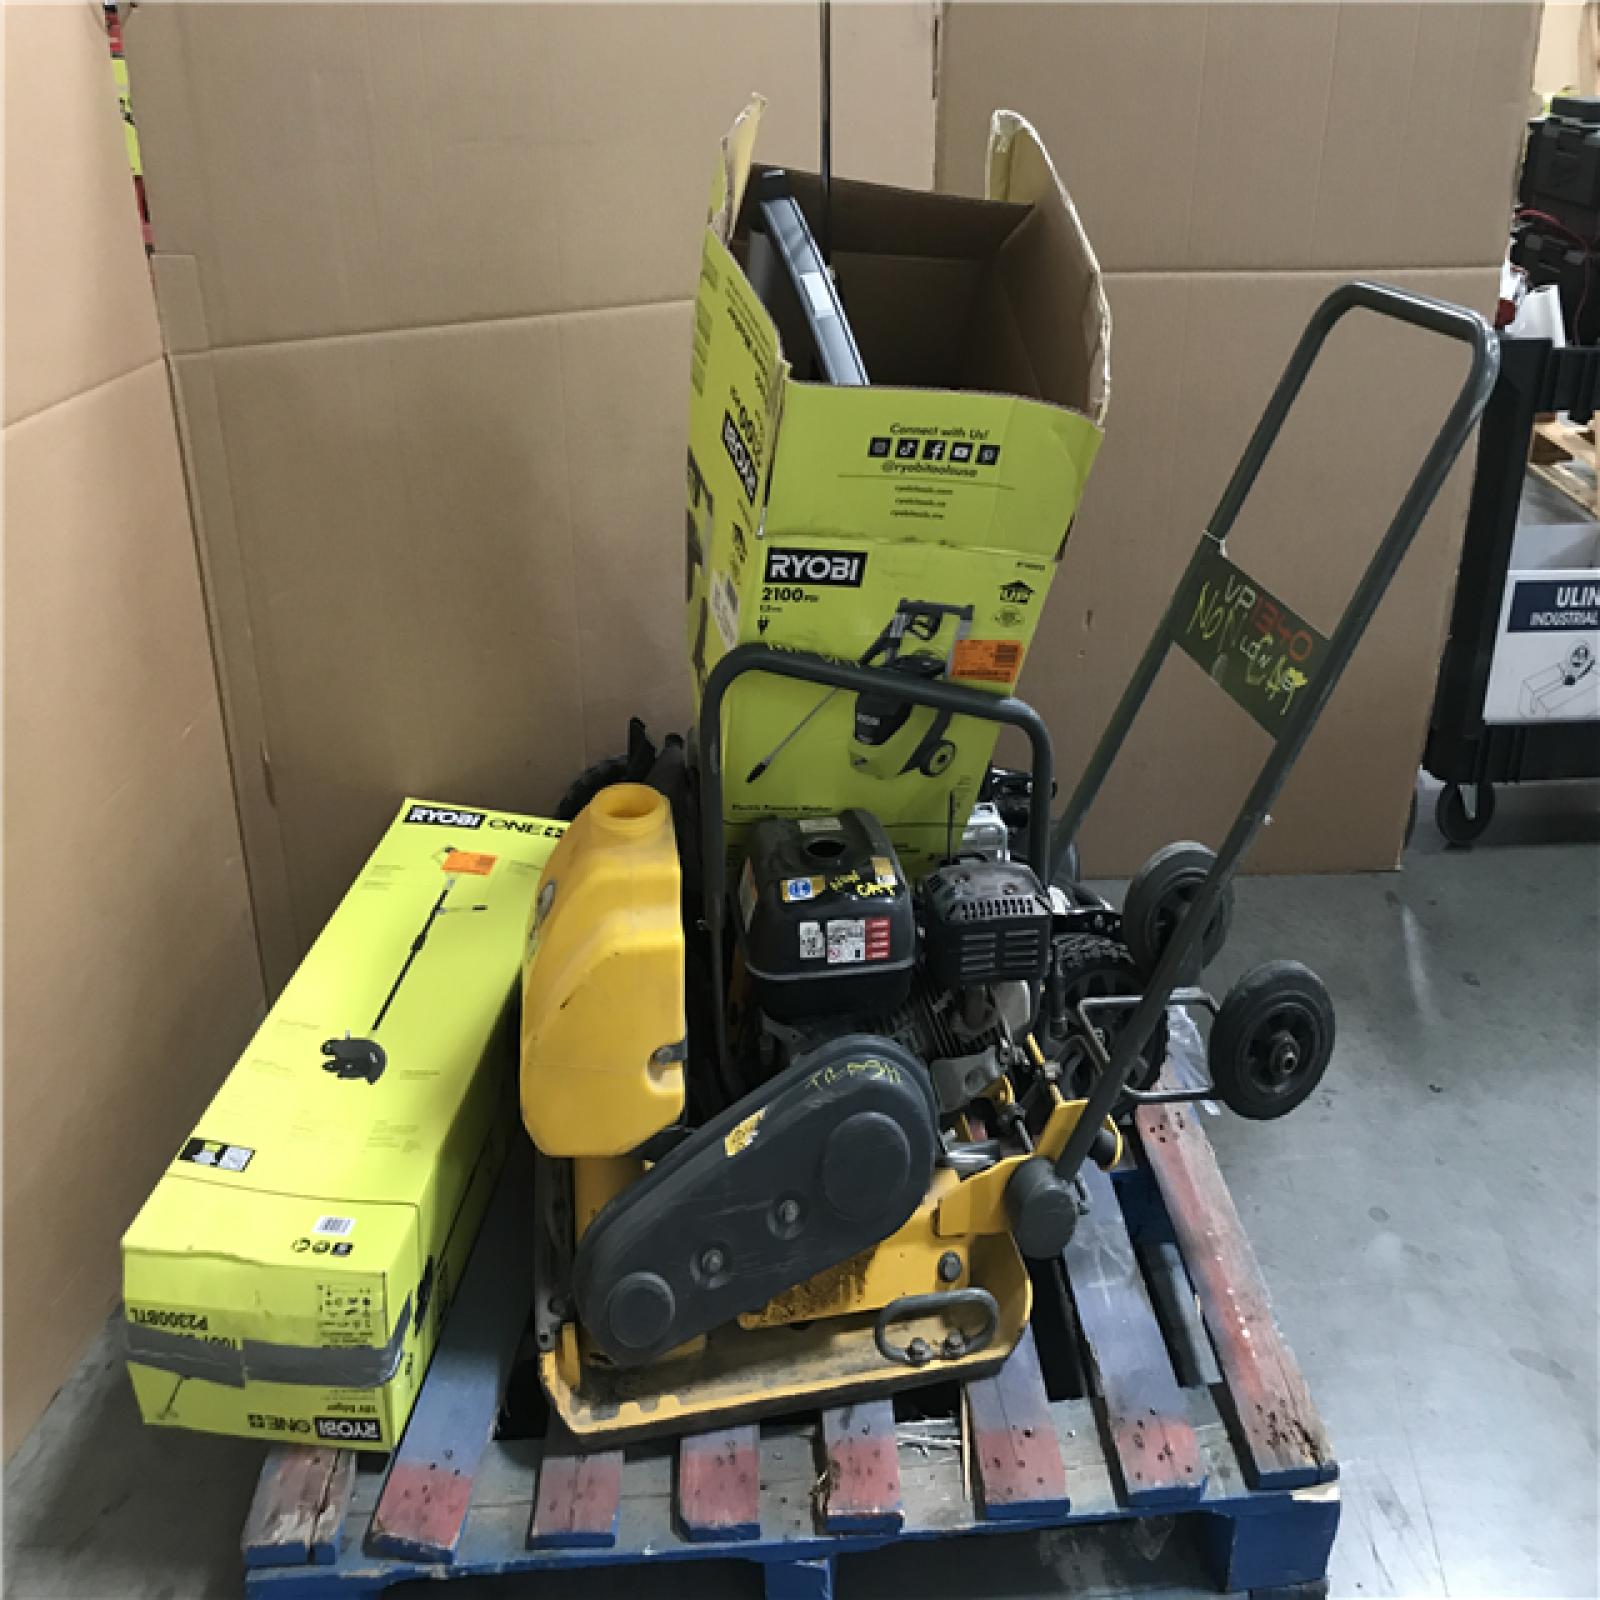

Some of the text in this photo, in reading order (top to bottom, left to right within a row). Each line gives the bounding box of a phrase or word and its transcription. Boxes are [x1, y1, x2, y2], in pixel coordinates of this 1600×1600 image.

[890, 422, 939, 435] Connect
[940, 426, 966, 438] with
[768, 553, 860, 581] RYOBI
[761, 586, 804, 603] 2100
[407, 806, 482, 827] RYOBI
[316, 1417, 381, 1440] RYOBI
